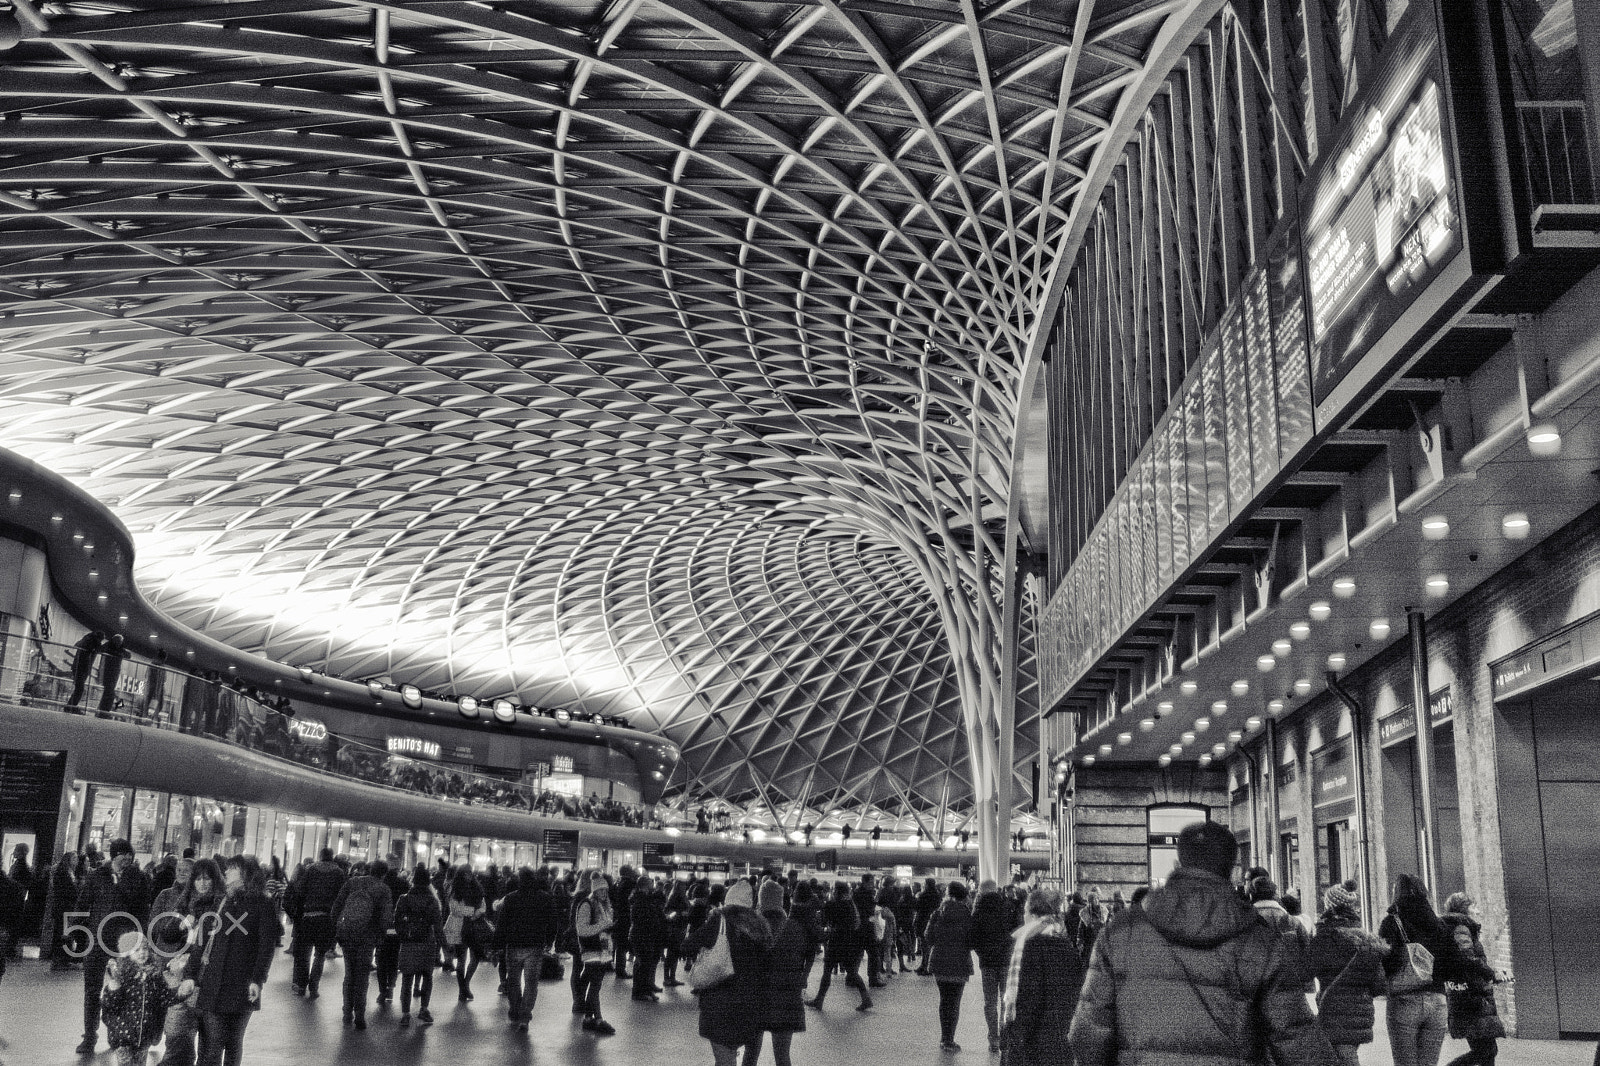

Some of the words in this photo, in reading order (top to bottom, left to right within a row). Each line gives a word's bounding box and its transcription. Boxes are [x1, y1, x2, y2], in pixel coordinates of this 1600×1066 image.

[1403, 228, 1420, 257] NEXT
[388, 738, 422, 751] BENITO'S
[424, 742, 439, 756] HAT
